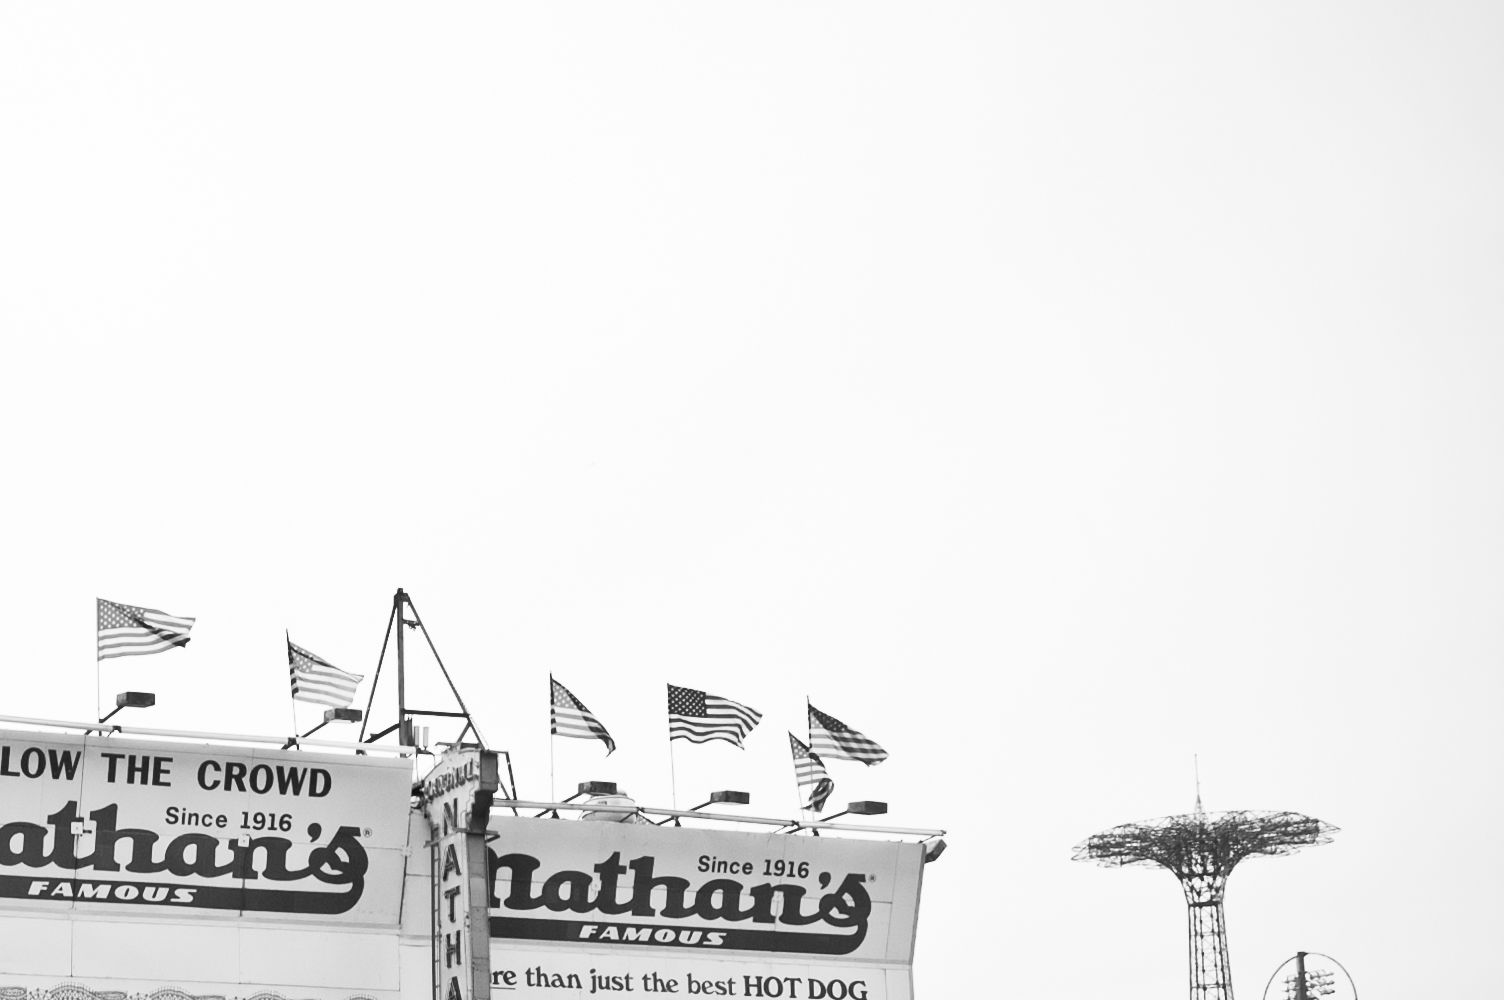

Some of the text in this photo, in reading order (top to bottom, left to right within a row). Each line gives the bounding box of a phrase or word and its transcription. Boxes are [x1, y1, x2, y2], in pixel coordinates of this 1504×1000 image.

[101, 753, 174, 788] THE
[197, 759, 332, 798] CROWD
[164, 806, 293, 832] Since 1916
[698, 854, 810, 879] Since 1916
[27, 880, 198, 903] FAMOUS
[578, 924, 728, 946] FAMOUS
[526, 966, 582, 990] than
[589, 972, 634, 994] just
[642, 971, 679, 994] the
[689, 974, 737, 997] best
[743, 974, 804, 999] HOT
